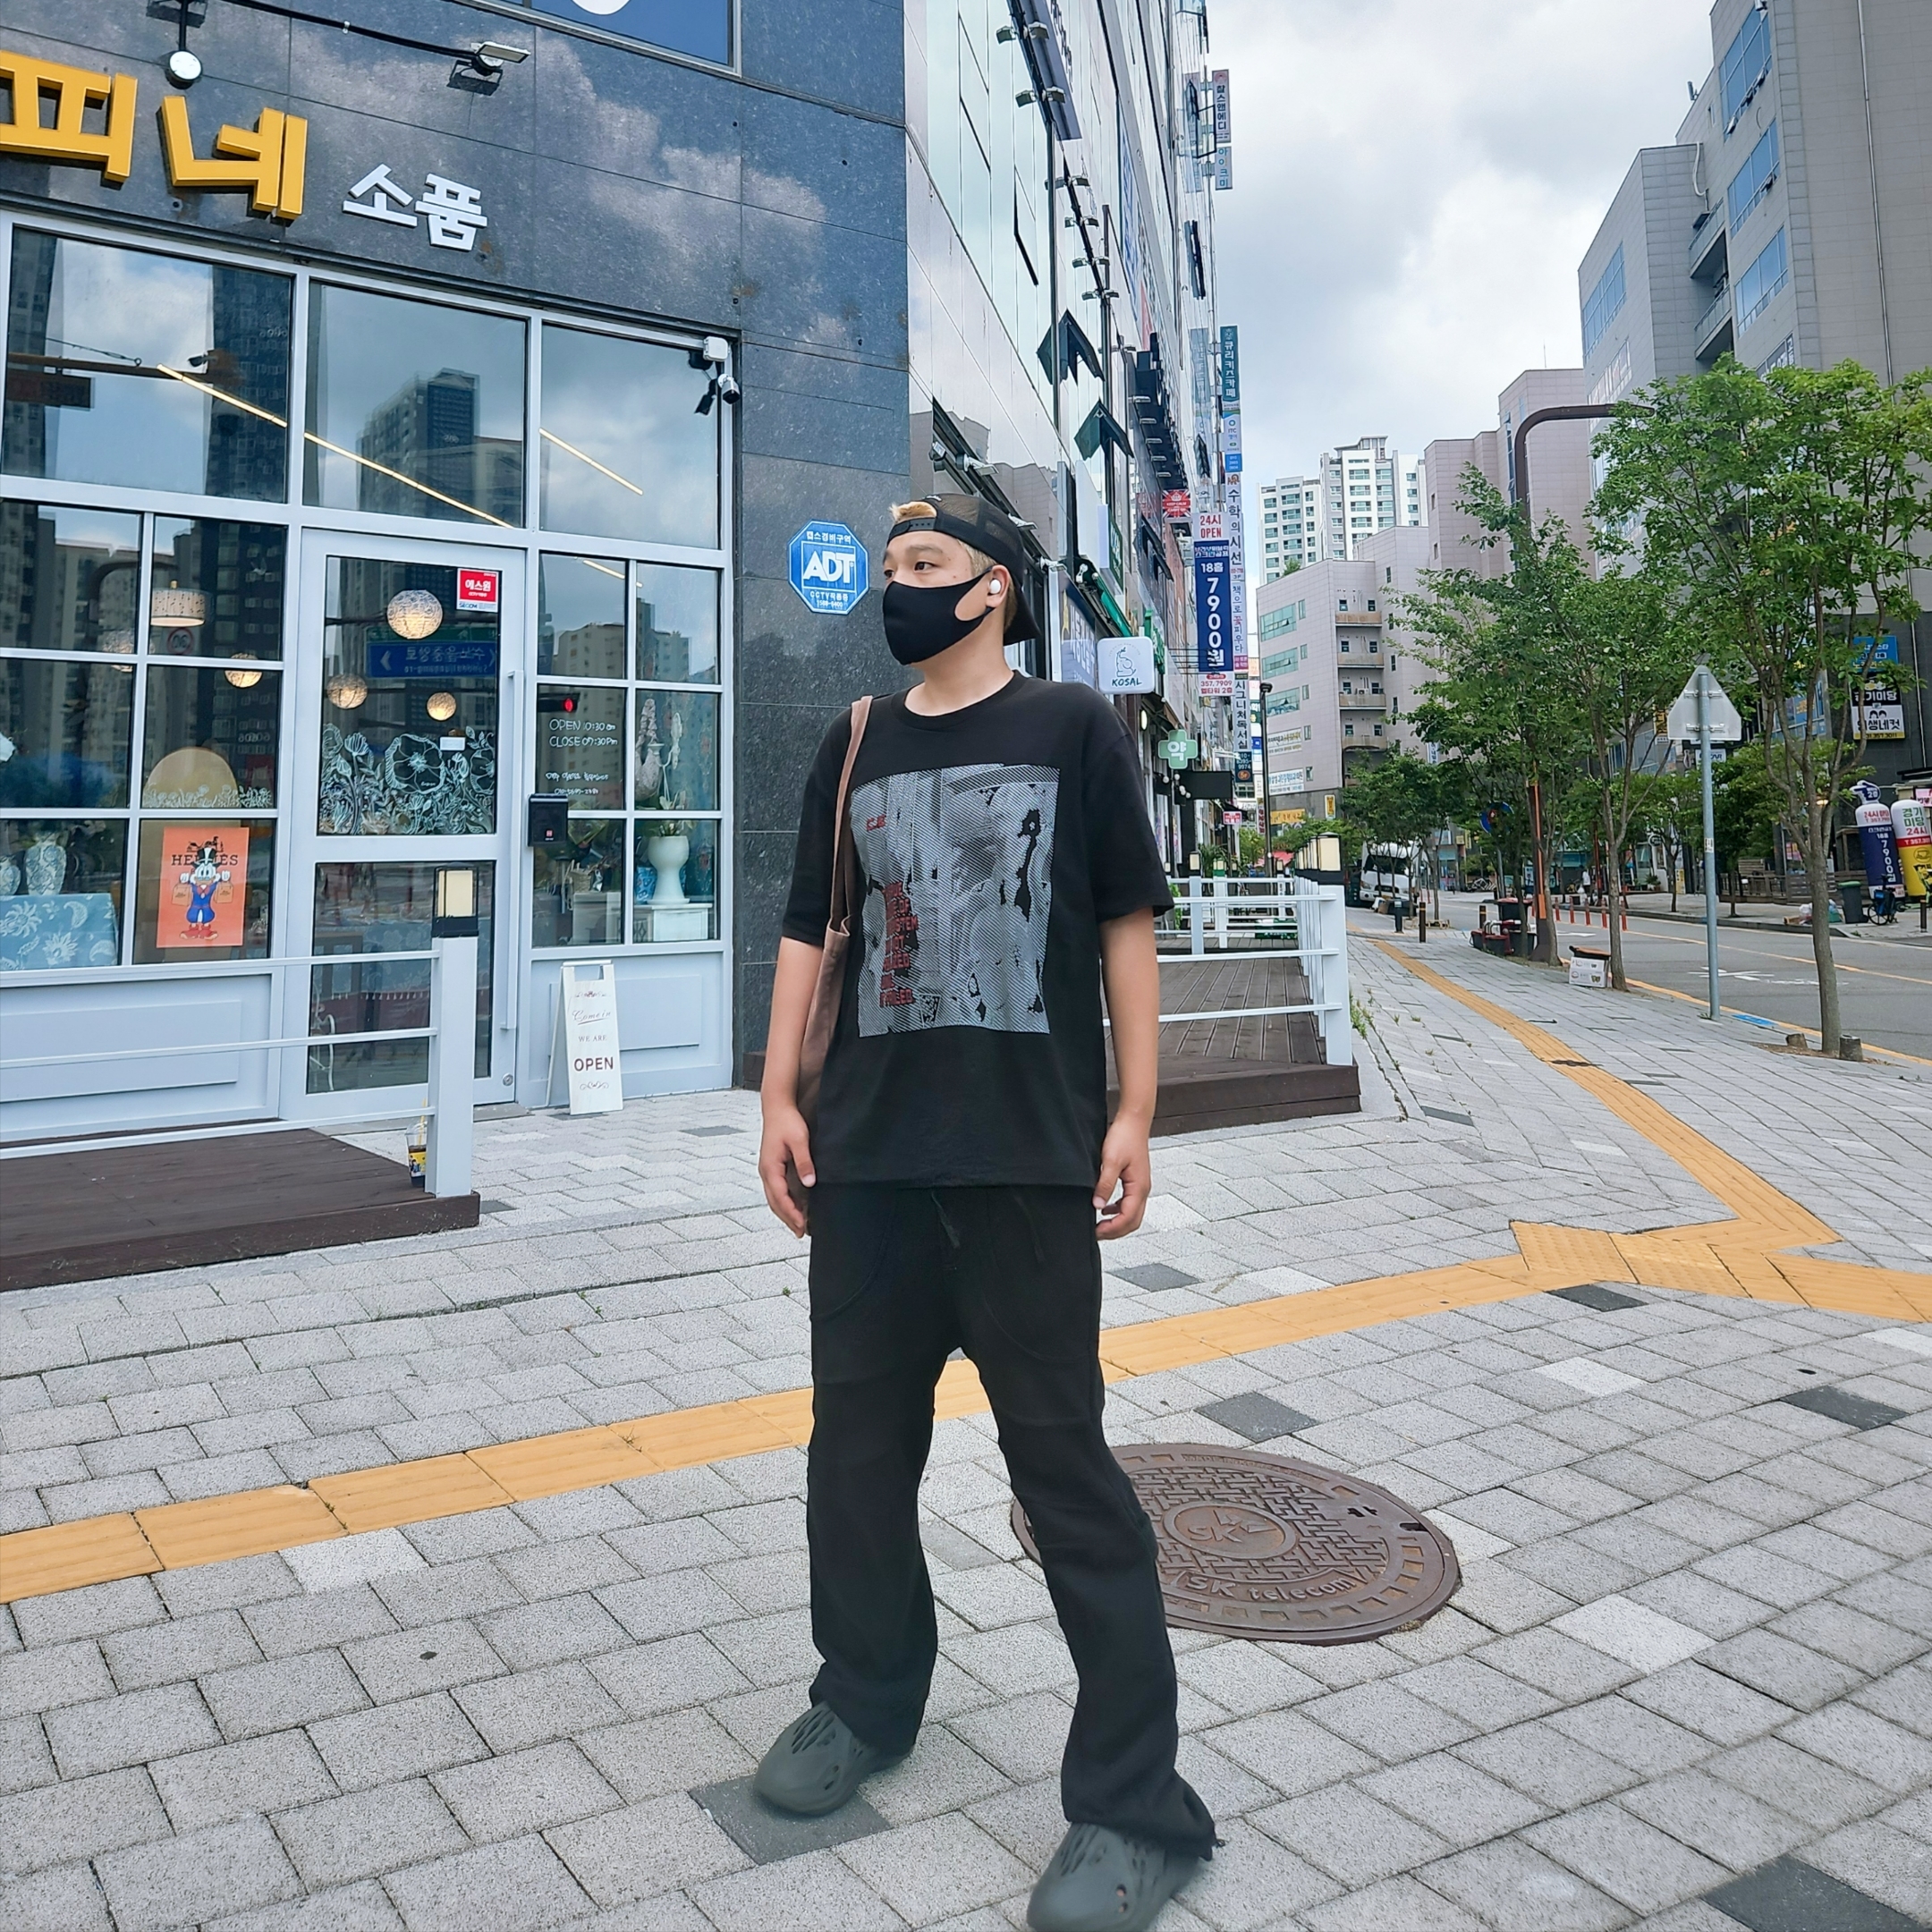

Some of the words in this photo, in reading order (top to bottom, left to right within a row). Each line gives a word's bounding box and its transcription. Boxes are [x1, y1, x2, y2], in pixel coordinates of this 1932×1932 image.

[343, 164, 488, 251] 소품
[1224, 341, 1236, 398] 큐리키즈카페
[1200, 514, 1222, 526] 24시
[1200, 528, 1222, 538] OPEN
[803, 550, 855, 584] ADT
[1201, 562, 1224, 572] 18홀
[465, 579, 491, 592] 에스원
[1111, 677, 1143, 687] KOSAL
[1235, 681, 1249, 750] 시그니처독서실
[549, 718, 581, 731] OPEN
[549, 735, 581, 748] CLOSE
[1167, 741, 1187, 761] 약
[1902, 807, 1923, 818] 경기
[1903, 818, 1925, 827] 미당
[1906, 826, 1928, 836] 24시
[573, 1056, 614, 1072] OPEN
[1188, 1526, 1243, 1543] SK
[1187, 1576, 1236, 1597] SK
[1249, 1576, 1358, 1601] telecom
